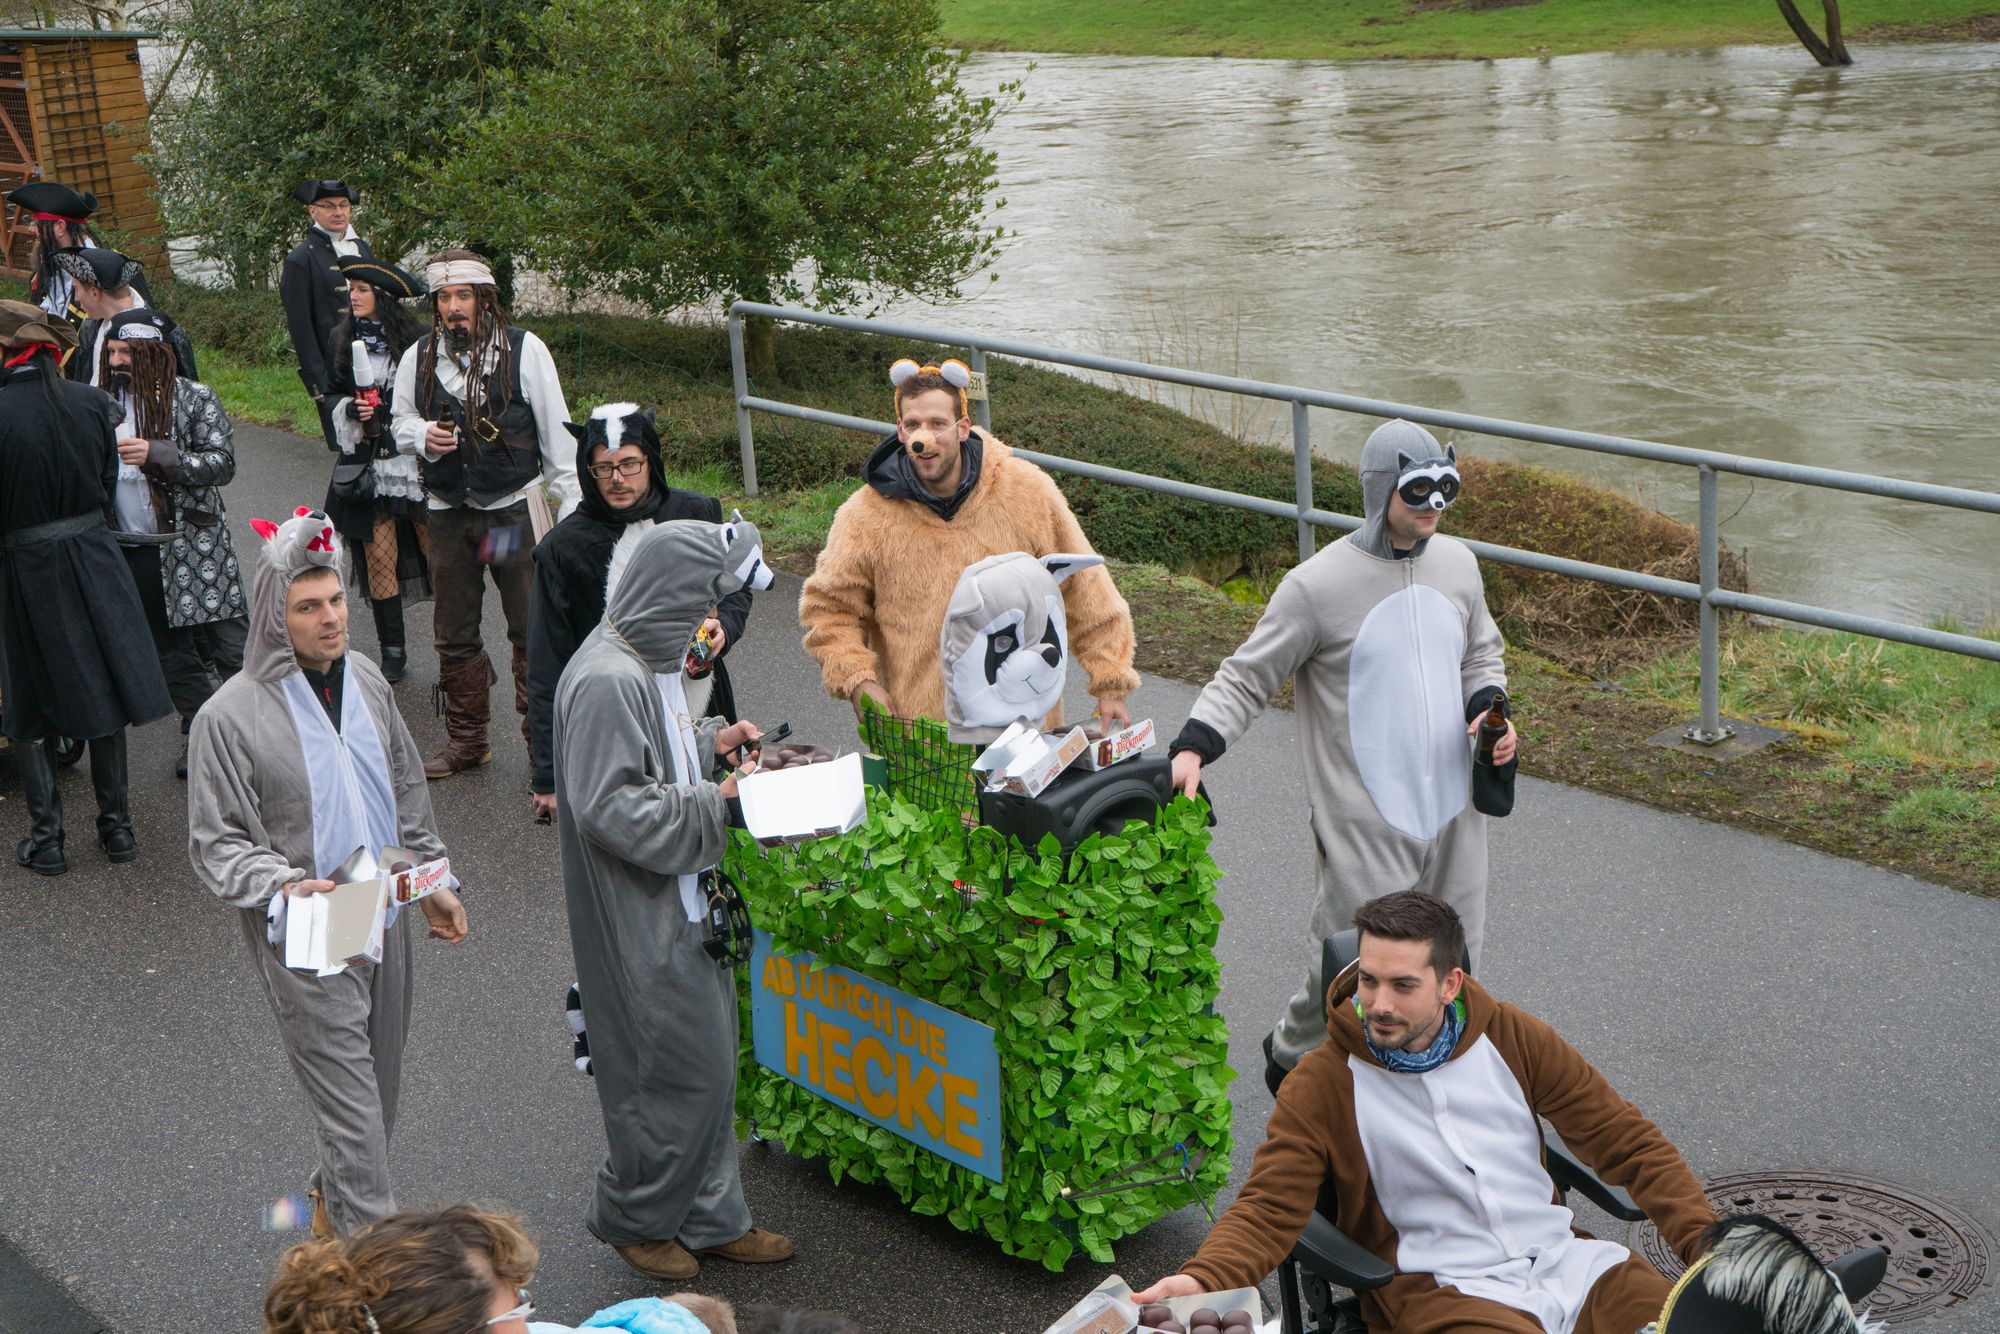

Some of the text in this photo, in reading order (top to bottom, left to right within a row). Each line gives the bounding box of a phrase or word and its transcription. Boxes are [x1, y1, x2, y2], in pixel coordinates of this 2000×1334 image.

[1115, 722, 1153, 754] Dickmann's
[1119, 730, 1134, 742] Super
[417, 866, 431, 878] Super
[762, 954, 948, 1068] AB DURCH DIE
[784, 1000, 983, 1159] HECKE
